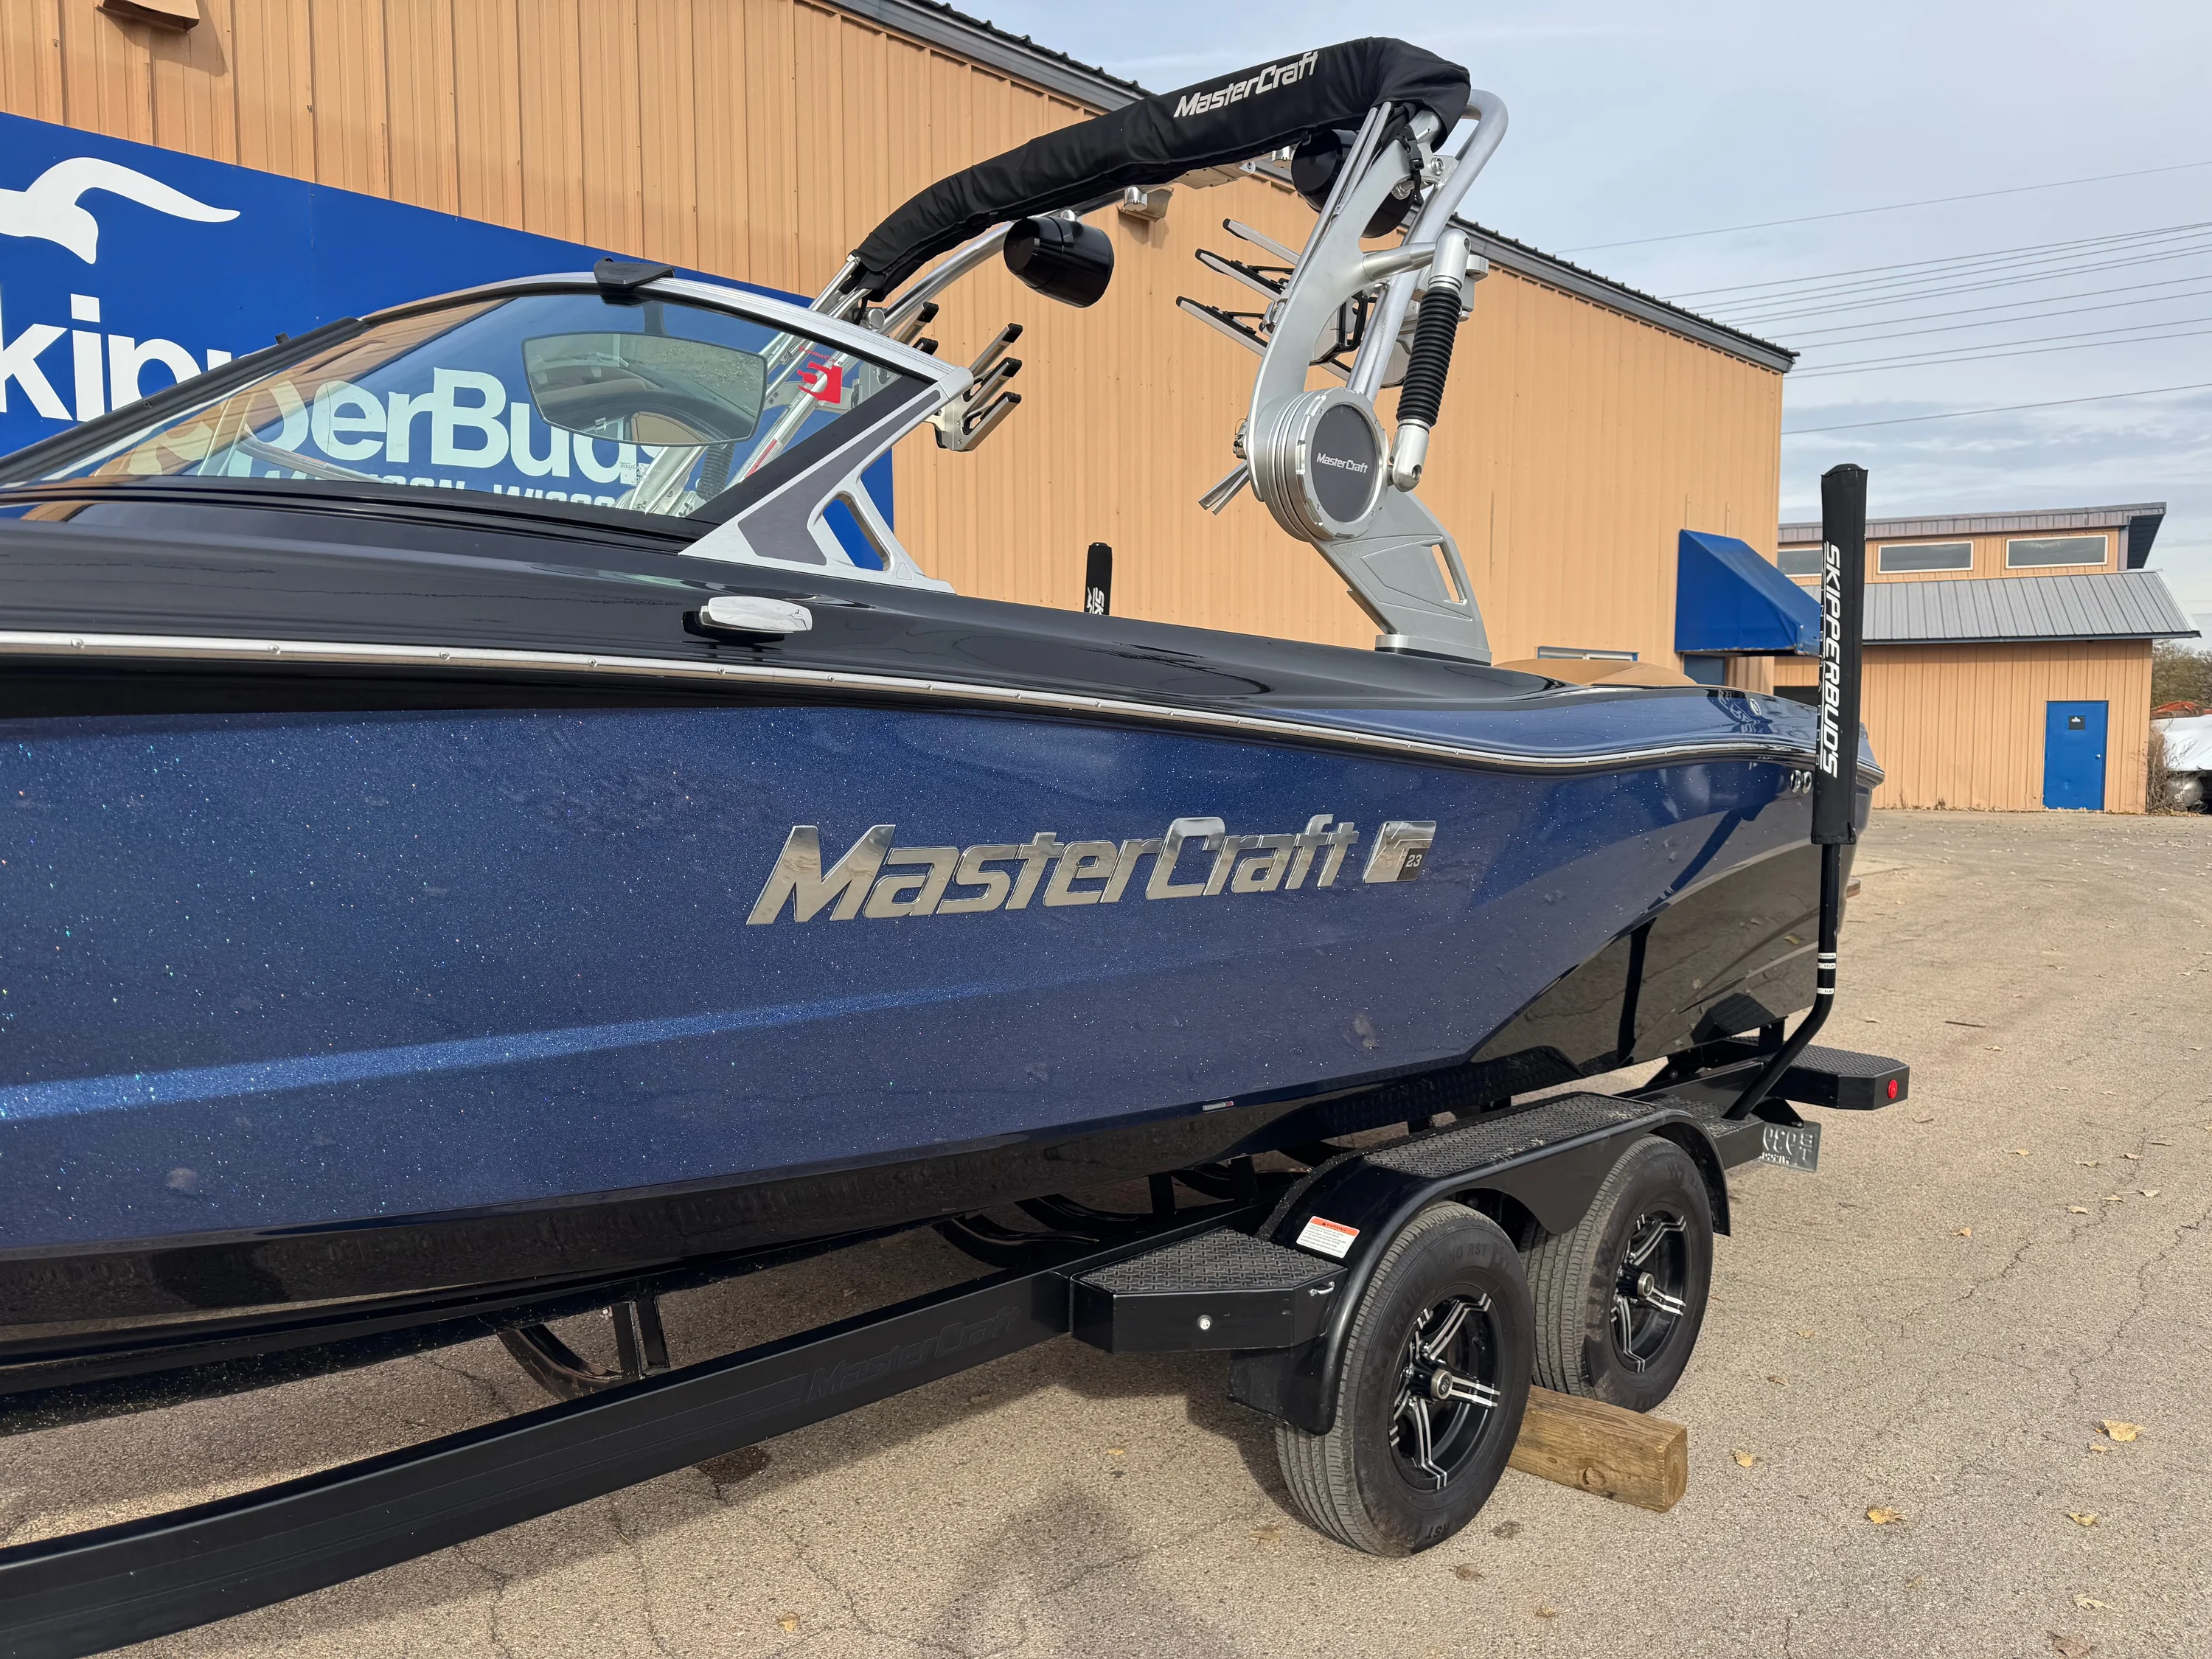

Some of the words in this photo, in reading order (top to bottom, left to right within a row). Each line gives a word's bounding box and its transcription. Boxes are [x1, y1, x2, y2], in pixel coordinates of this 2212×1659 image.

[1173, 50, 1319, 118] MasterCraft
[1317, 453, 1368, 473] MasterCraft
[1823, 542, 1841, 778] SKIPPERBUD'S
[746, 814, 1359, 925] MasterCraft
[1405, 854, 1422, 868] 23
[1467, 1243, 1487, 1256] RST
[807, 1306, 1022, 1402] MasterCraft
